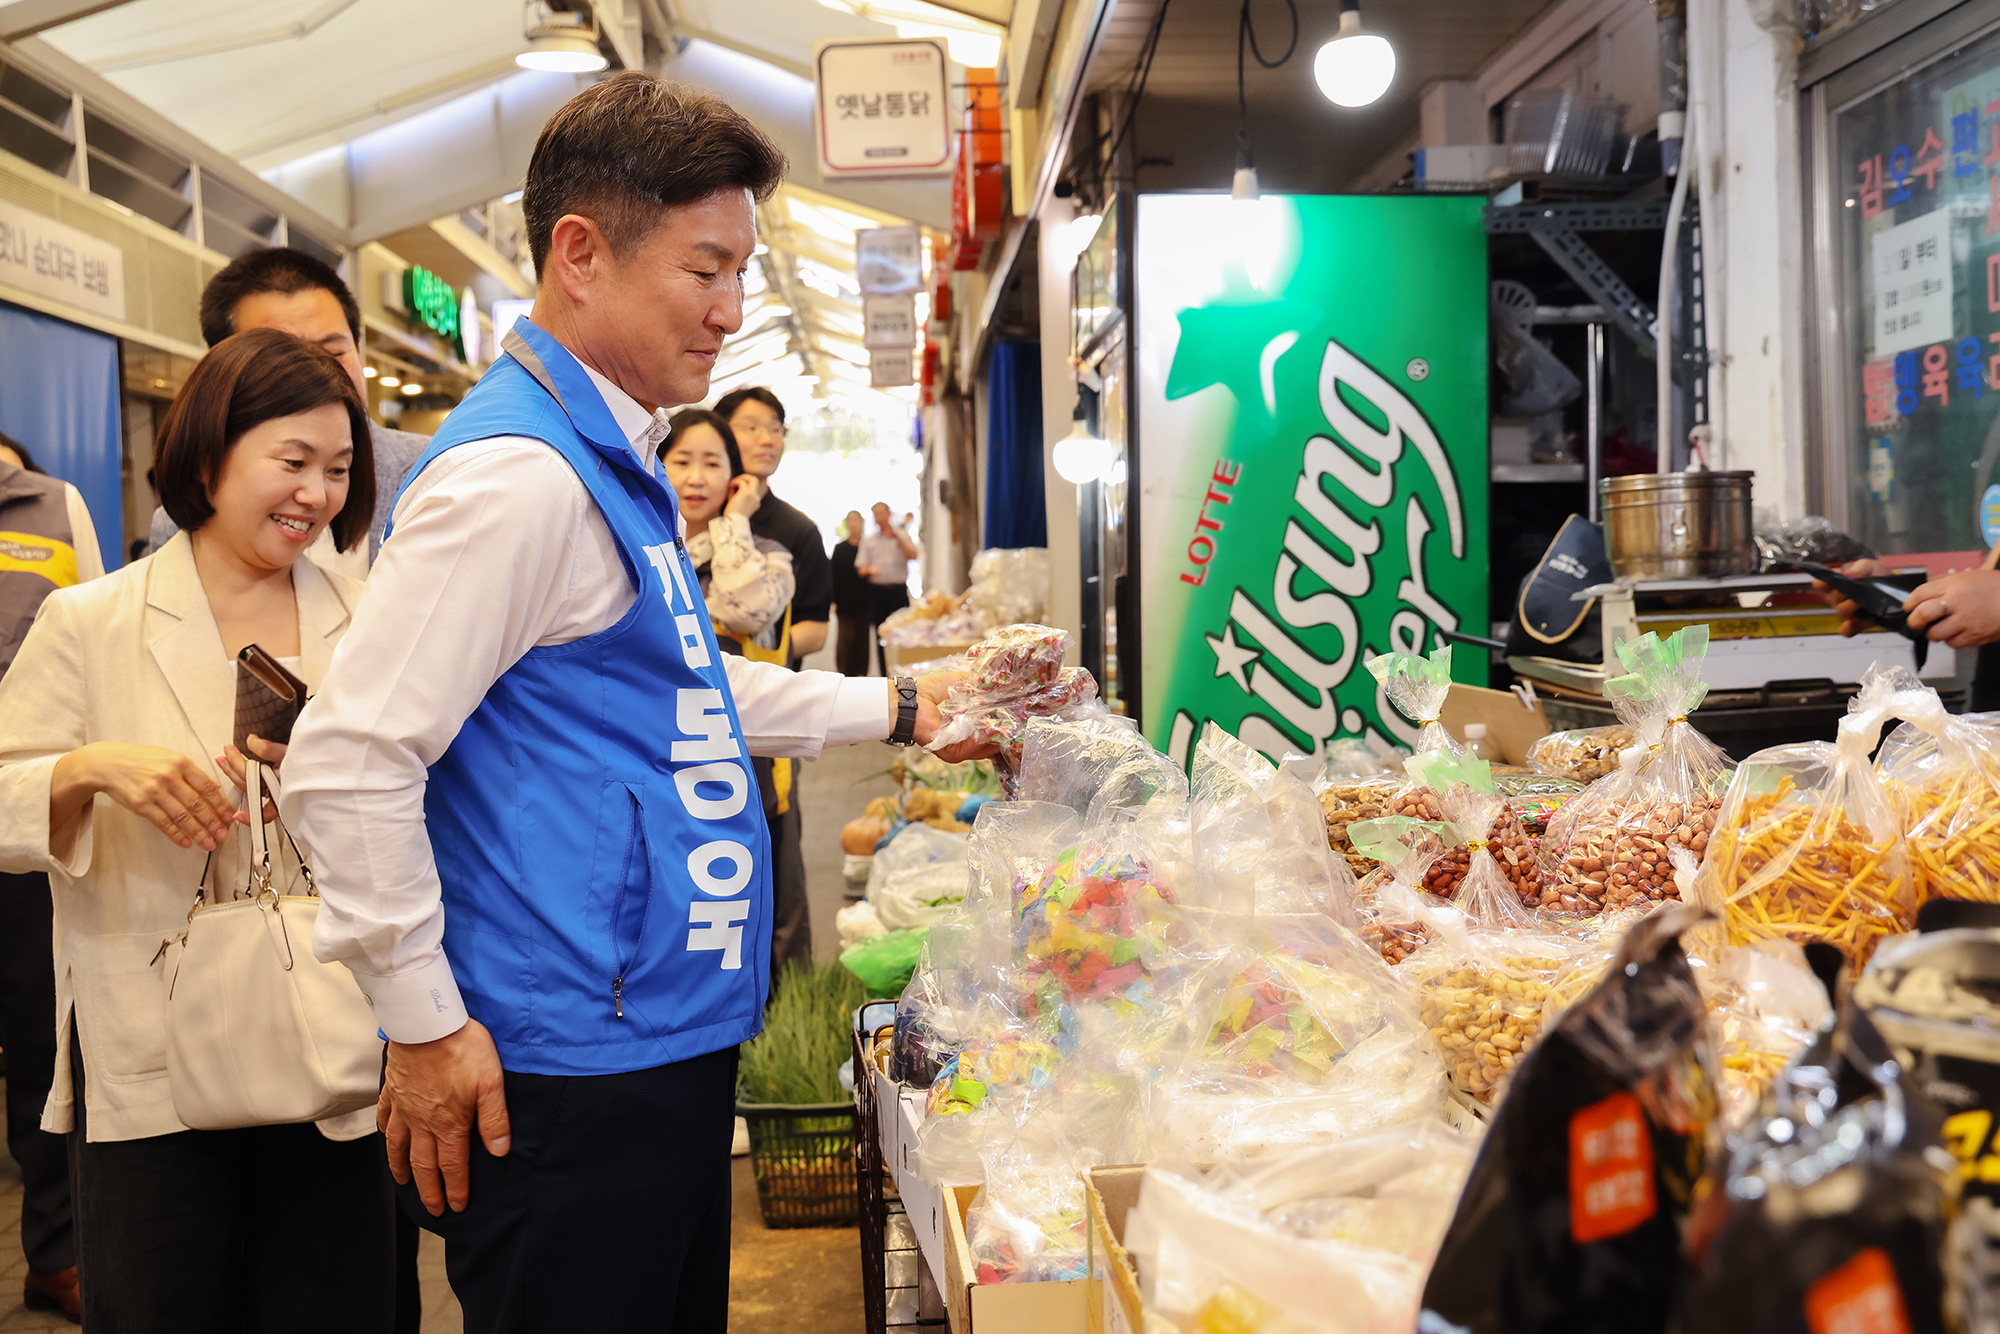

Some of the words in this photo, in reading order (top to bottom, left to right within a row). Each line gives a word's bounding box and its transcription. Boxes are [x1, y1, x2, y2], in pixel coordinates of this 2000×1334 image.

[836, 89, 930, 120] 옛날통닭
[34, 235, 78, 288] 순대국
[83, 253, 110, 297] 보쌈
[1168, 337, 1467, 778] hilsung
[1179, 458, 1242, 587] LOTTE
